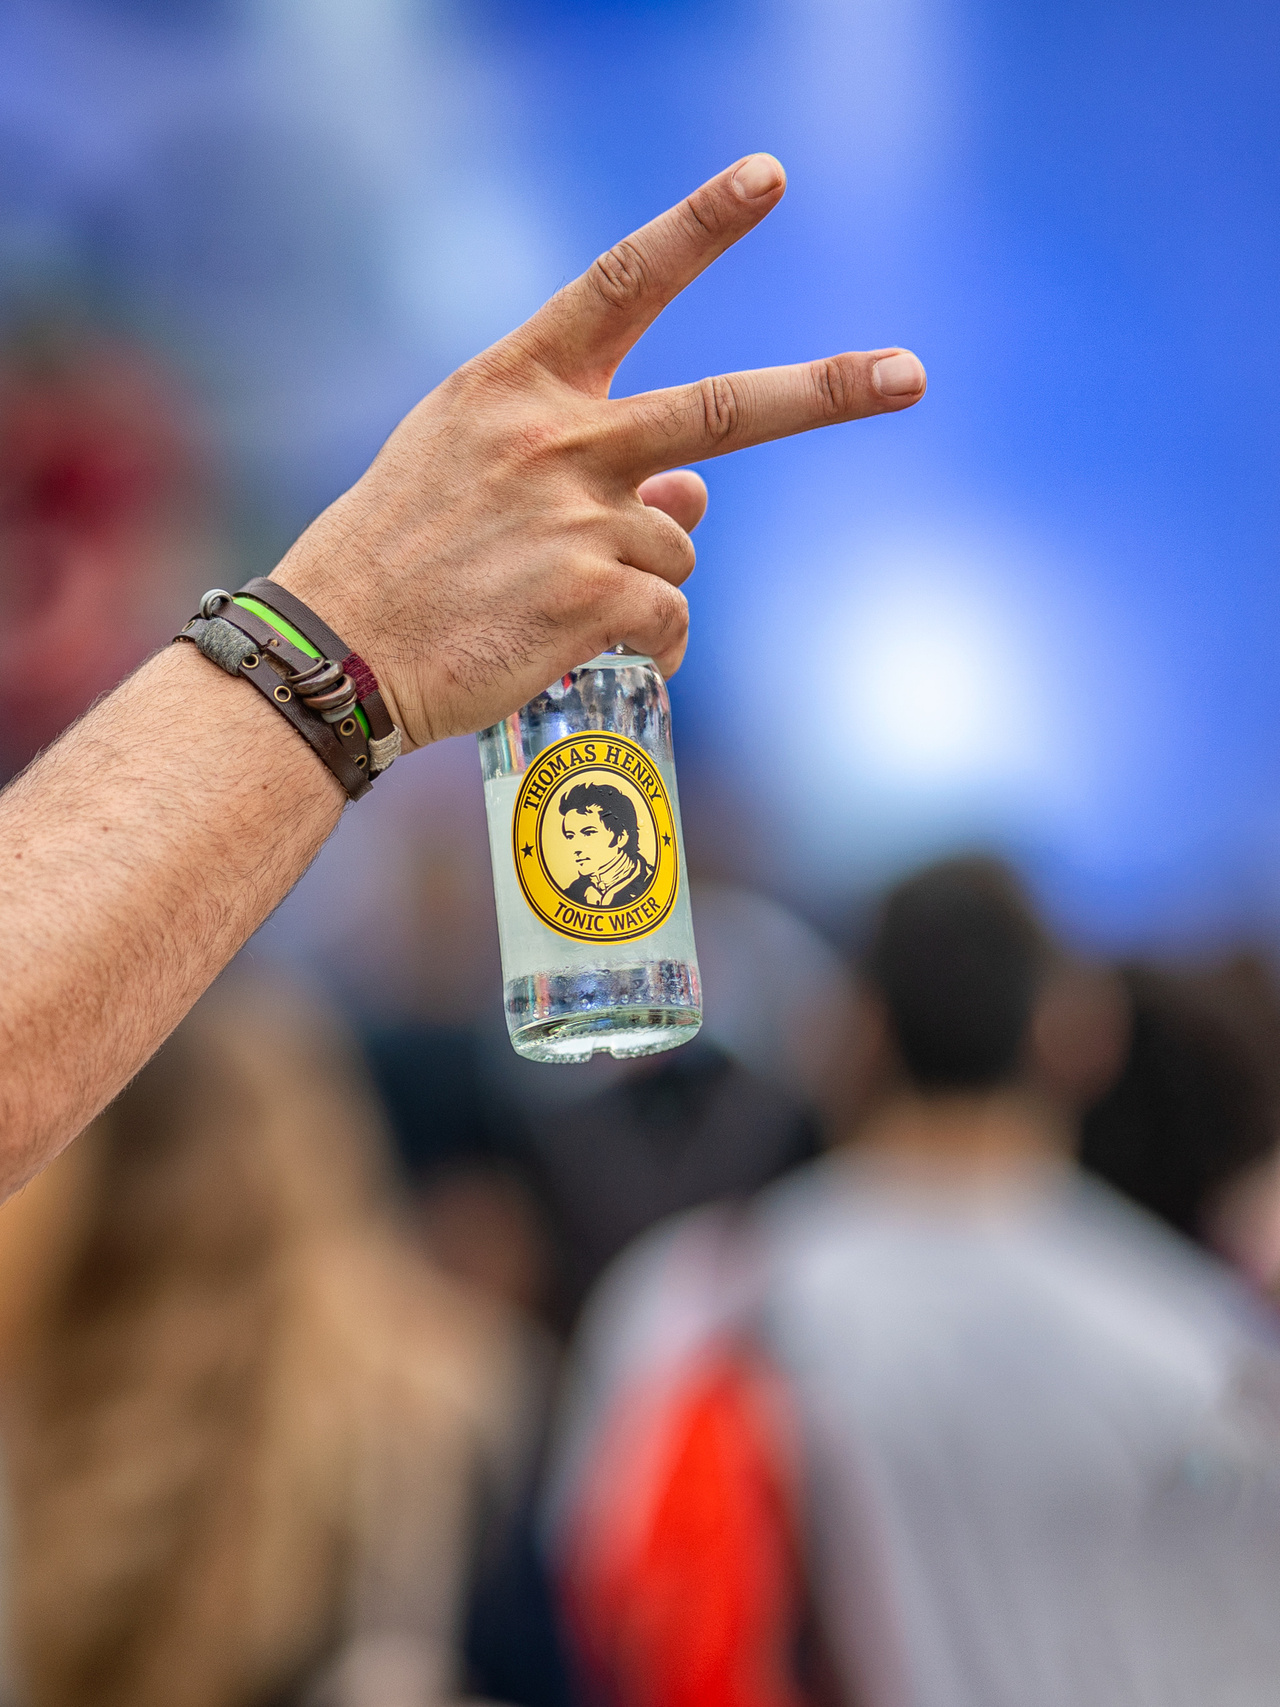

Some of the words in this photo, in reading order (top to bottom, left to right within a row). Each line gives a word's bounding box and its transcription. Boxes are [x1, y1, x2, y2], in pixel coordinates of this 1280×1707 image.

[523, 744, 597, 811] THOMAS
[604, 744, 662, 802] HENRY
[553, 901, 604, 932] TONIC
[608, 896, 661, 932] WATER
